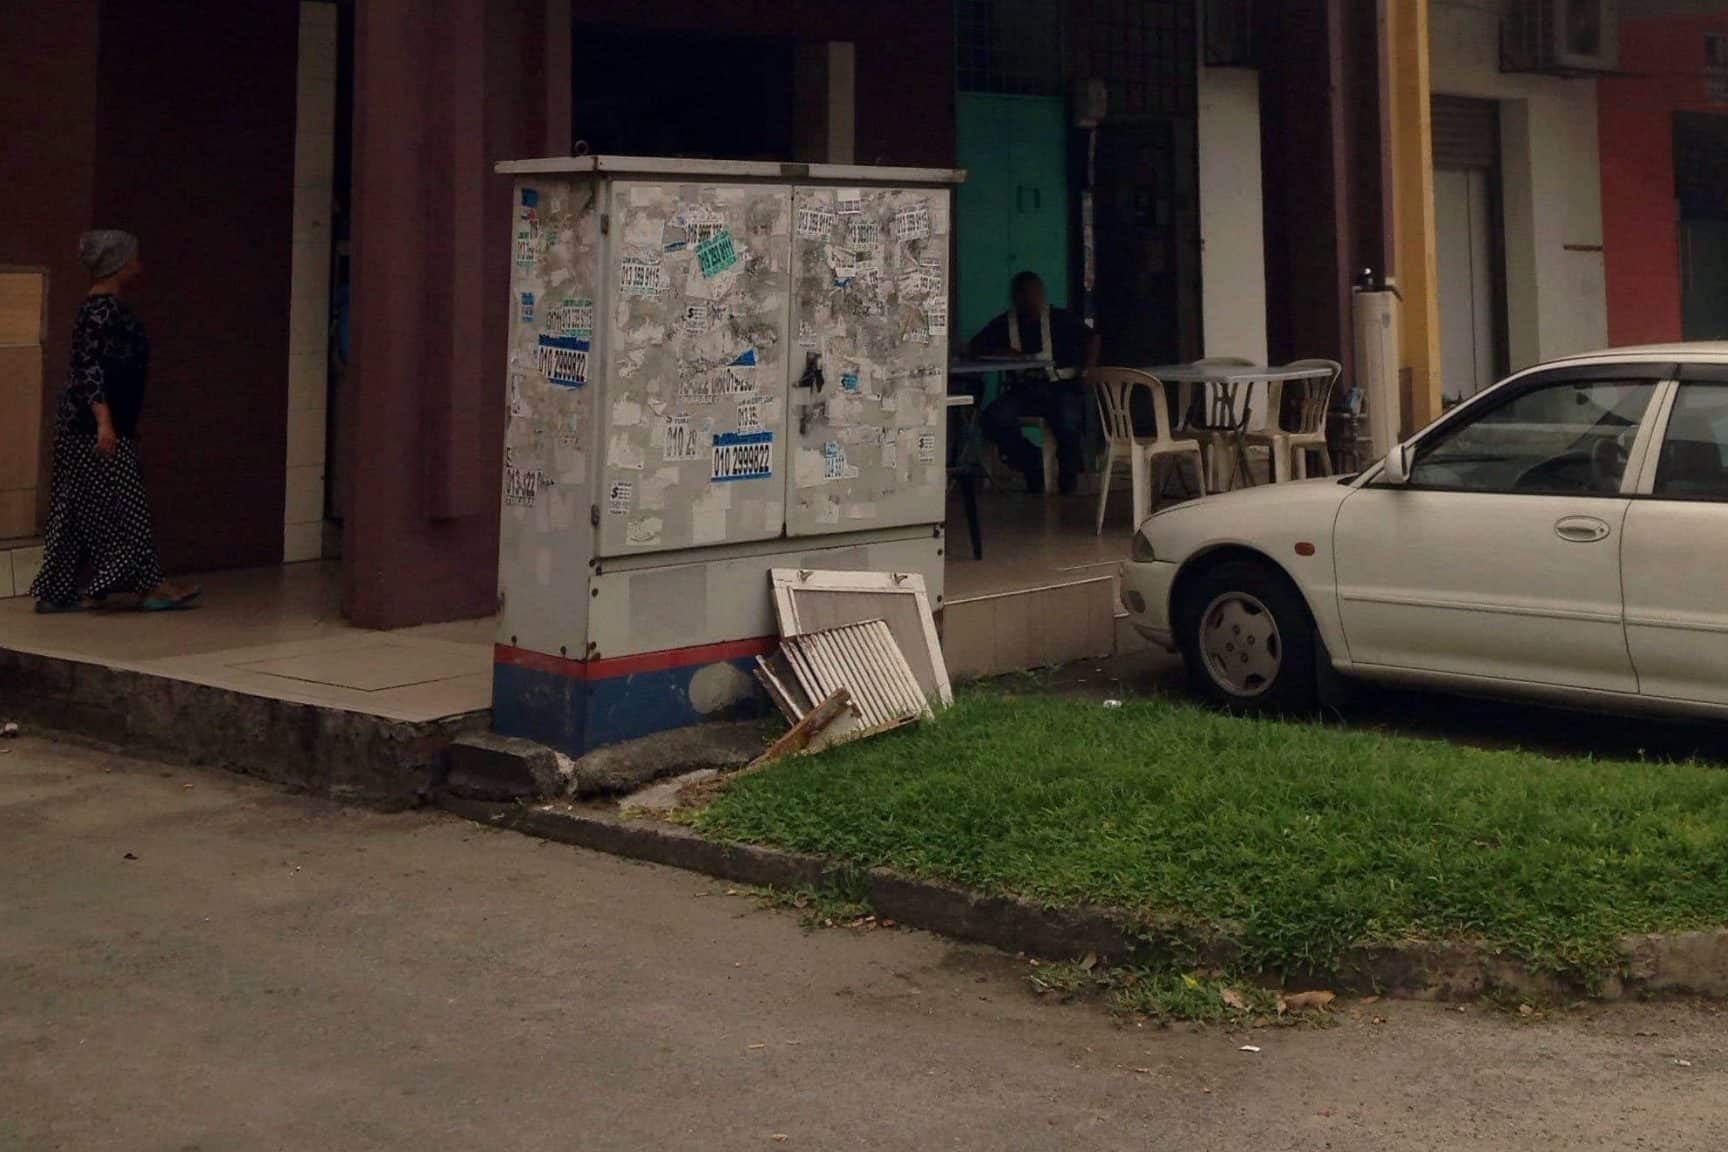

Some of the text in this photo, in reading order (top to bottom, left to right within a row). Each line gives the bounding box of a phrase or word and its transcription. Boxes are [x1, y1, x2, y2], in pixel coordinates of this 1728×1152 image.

[554, 350, 586, 382] 2999822
[714, 444, 770, 477] 010 2999822
